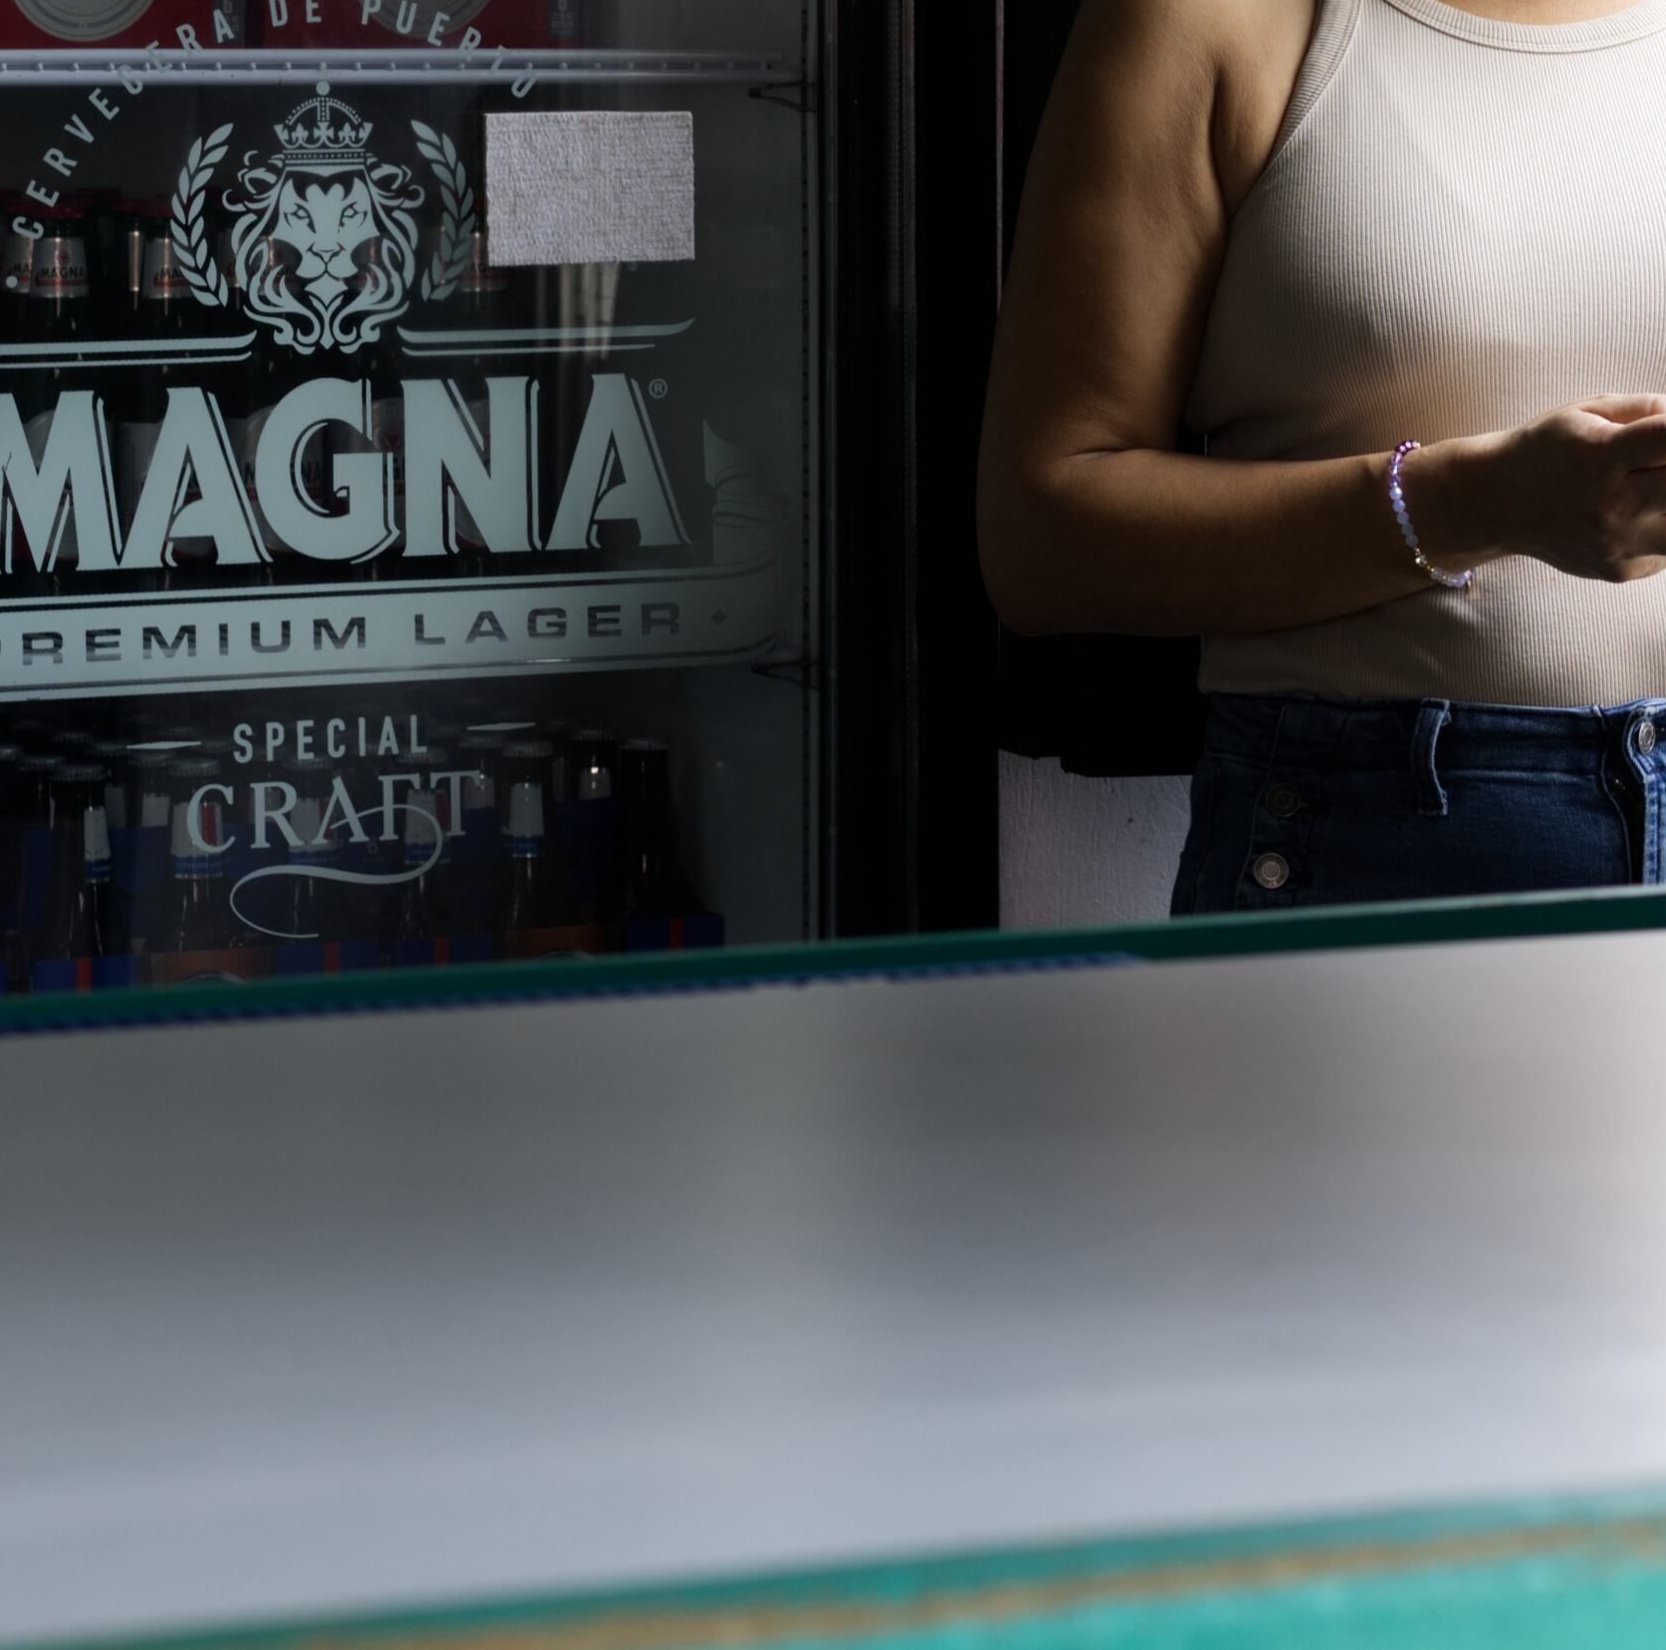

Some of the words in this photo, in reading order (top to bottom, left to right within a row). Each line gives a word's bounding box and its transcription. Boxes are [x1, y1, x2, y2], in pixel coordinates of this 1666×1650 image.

[11, 8, 237, 242] CERVECERA
[412, 599, 684, 648] LAGER
[233, 713, 431, 765] SPECIAL
[186, 769, 483, 866] CRAFT
